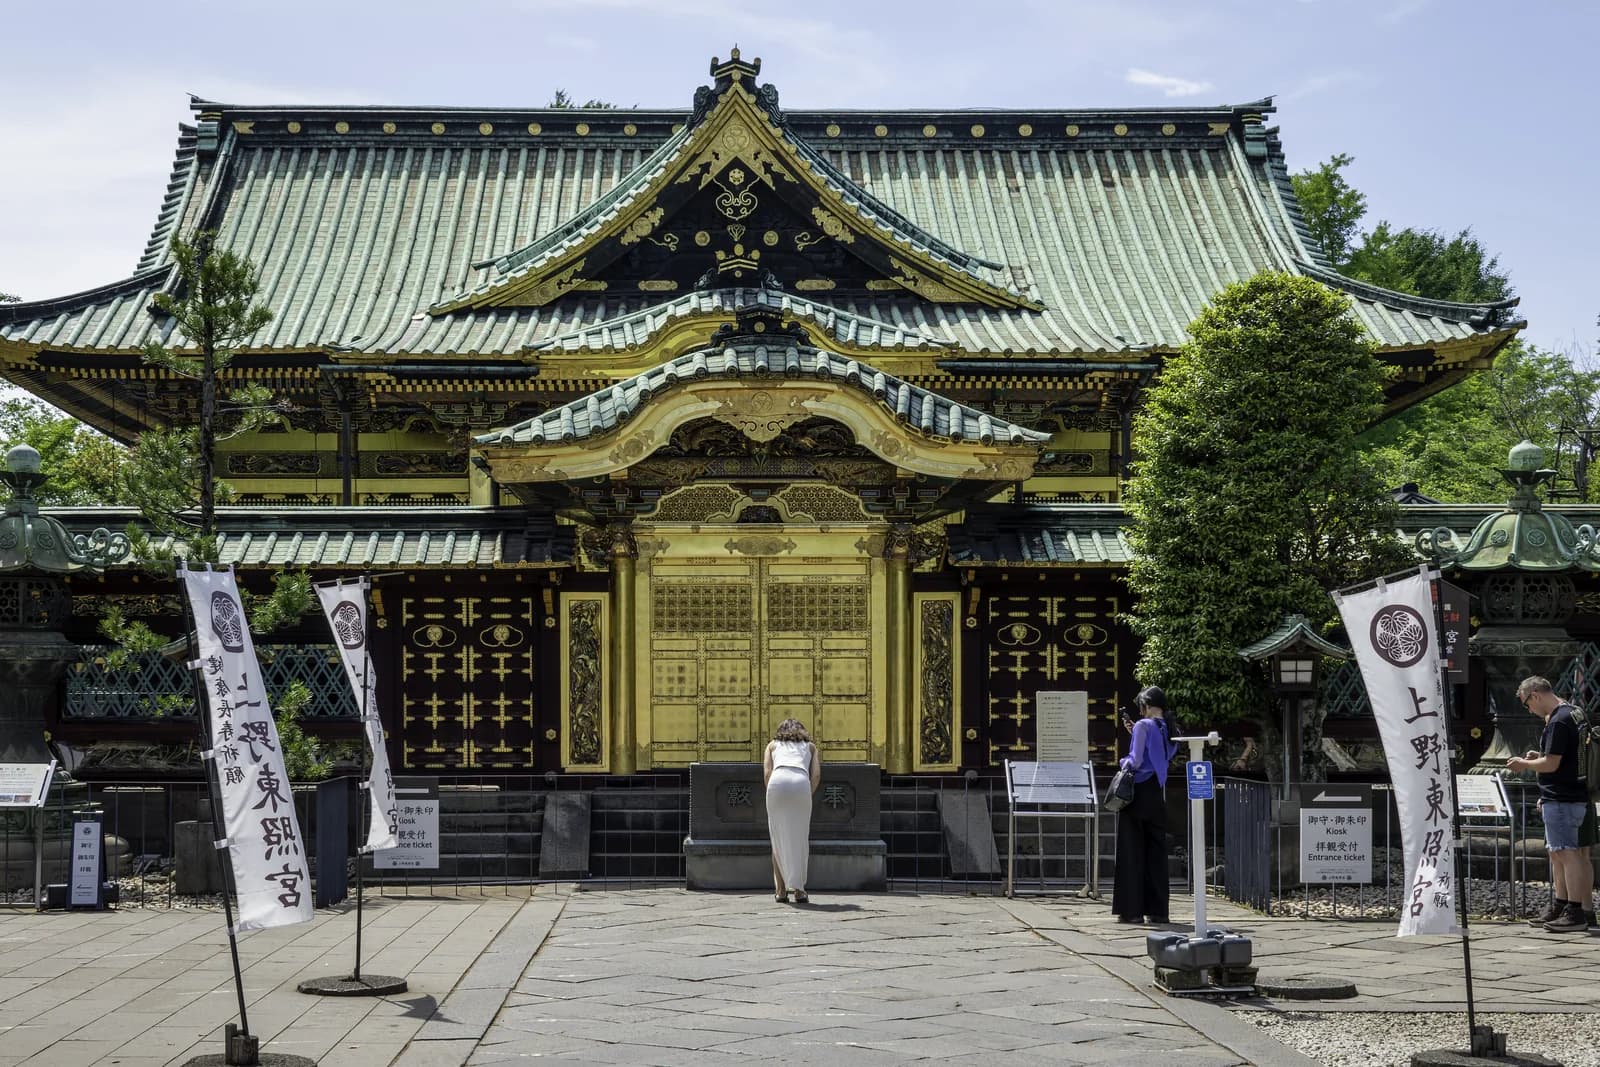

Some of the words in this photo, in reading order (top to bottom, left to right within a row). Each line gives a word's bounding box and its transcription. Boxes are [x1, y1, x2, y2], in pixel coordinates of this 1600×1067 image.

[1326, 827, 1347, 835] Kiosk
[1316, 841, 1358, 852] 拝観受付
[1308, 853, 1341, 861] Entrance
[1344, 853, 1365, 861] ticket
